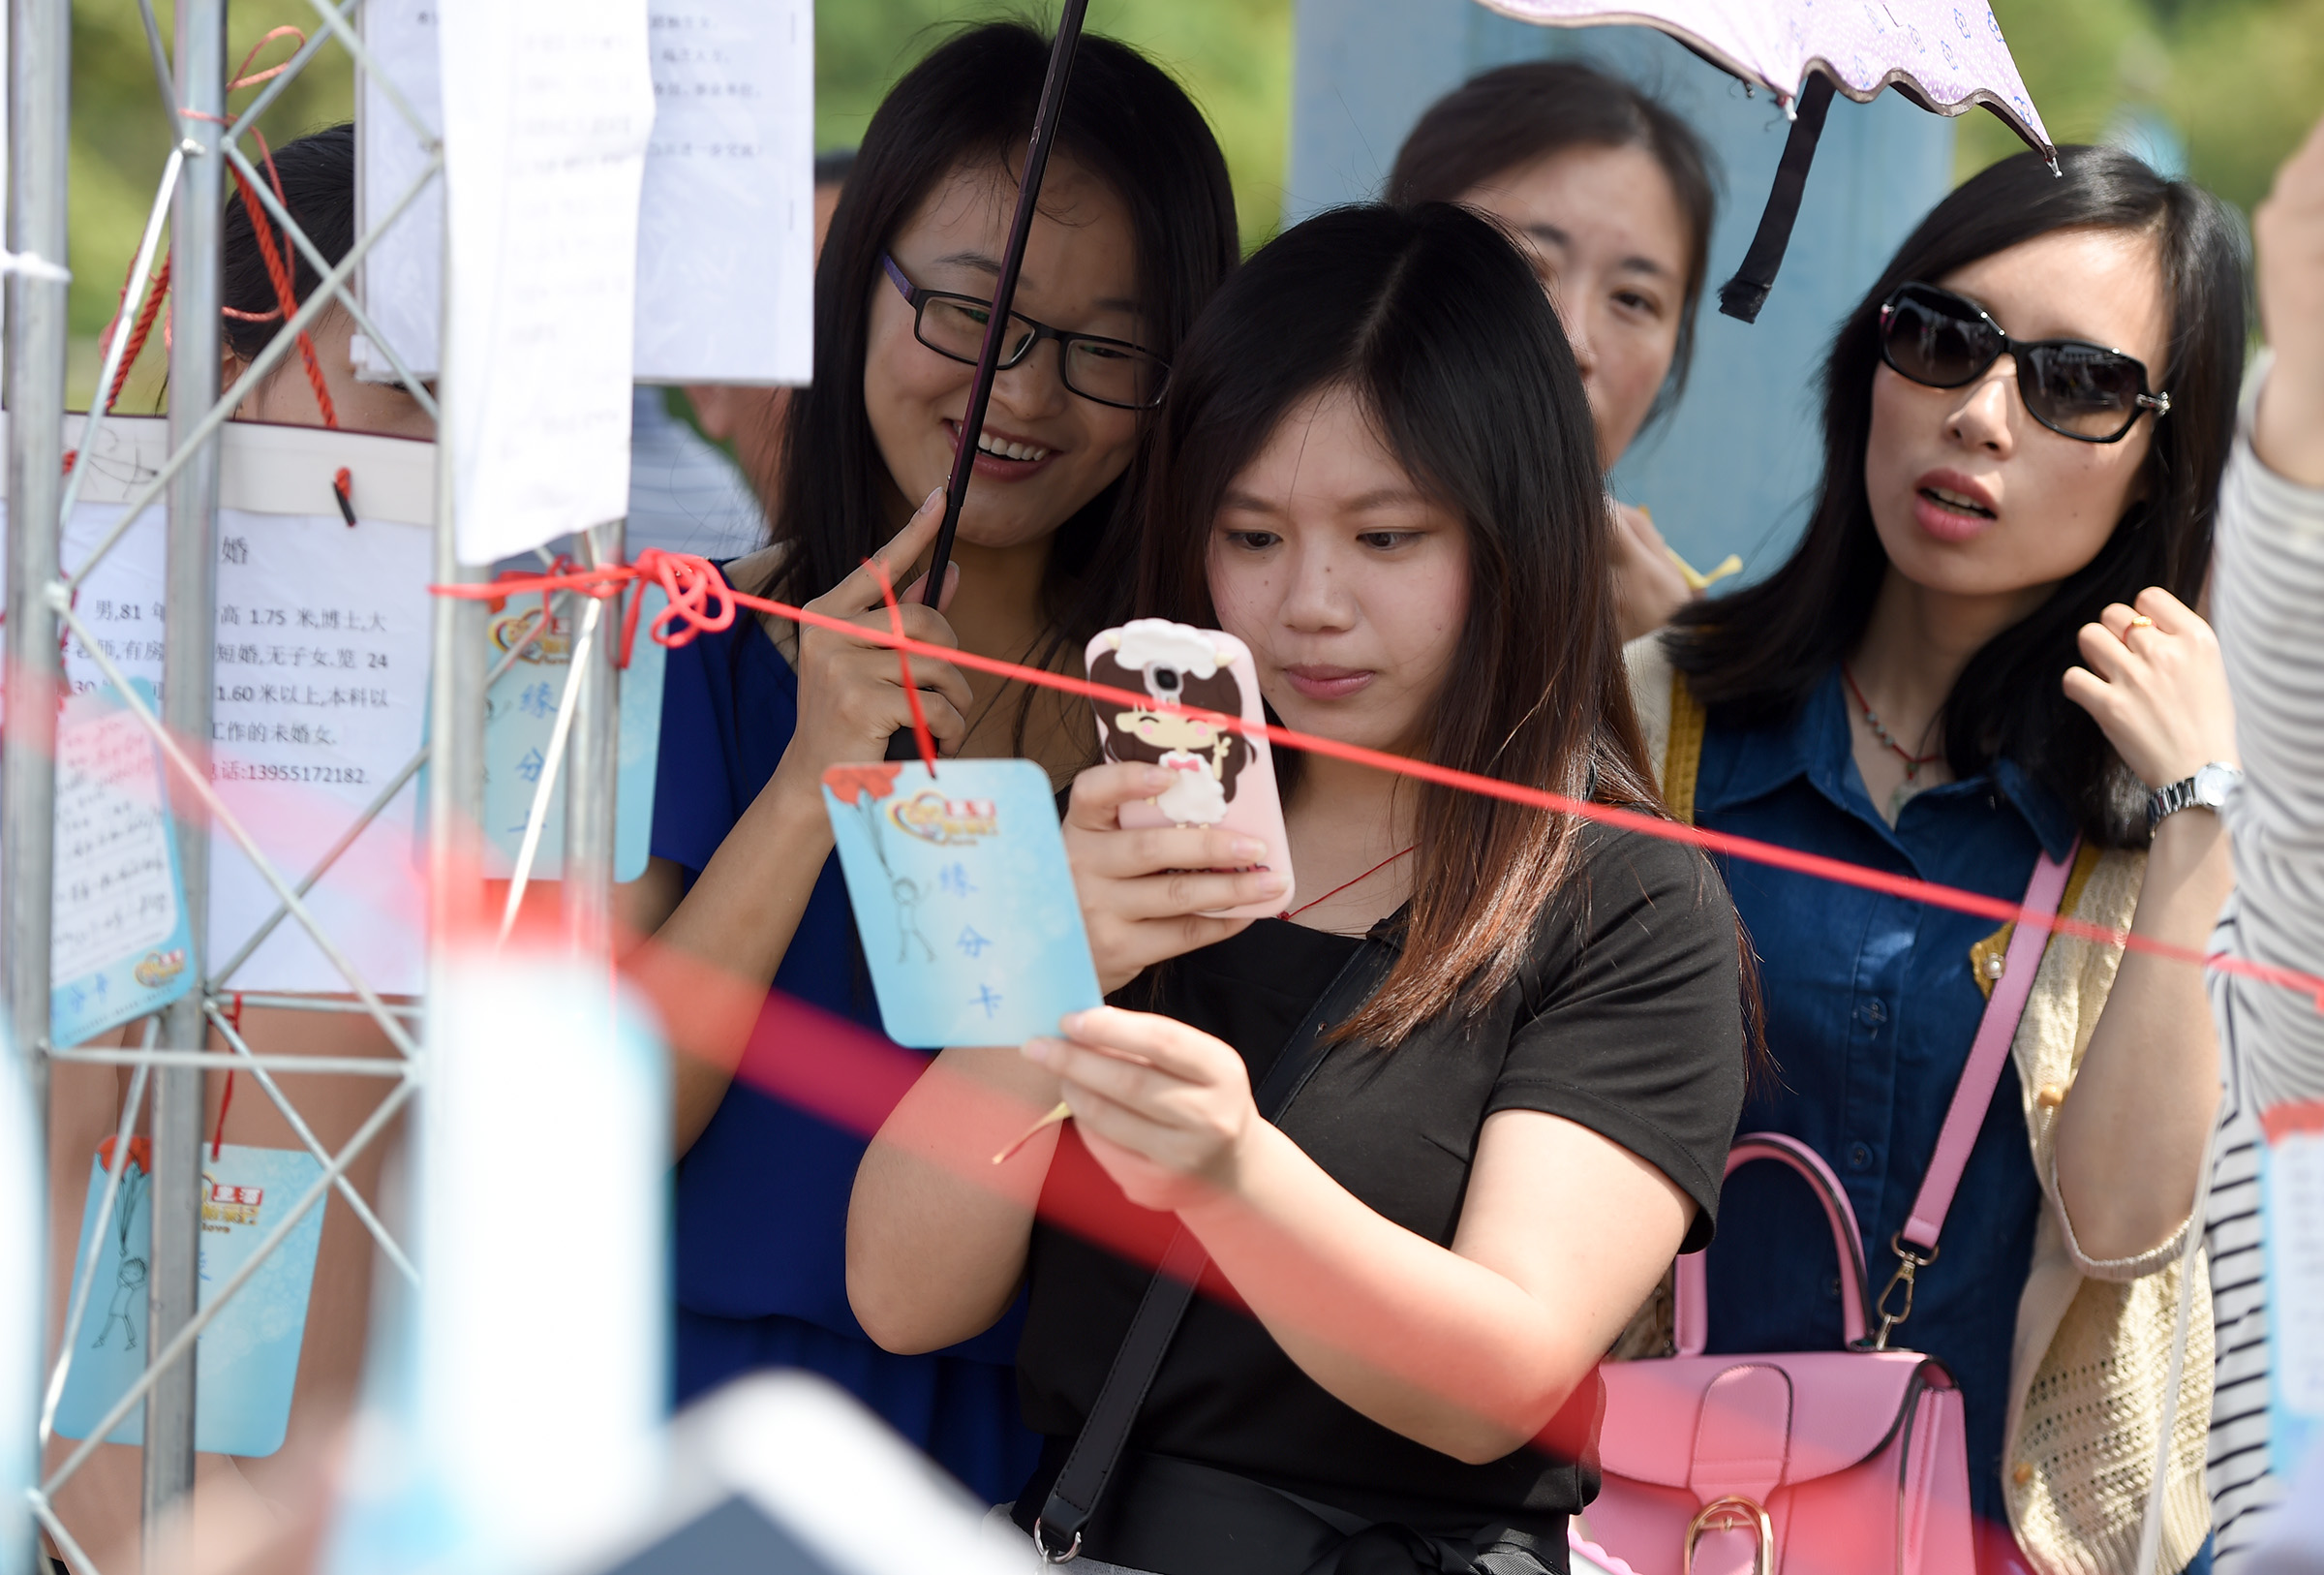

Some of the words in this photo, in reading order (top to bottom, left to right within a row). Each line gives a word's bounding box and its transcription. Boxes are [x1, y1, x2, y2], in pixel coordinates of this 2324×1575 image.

[222, 536, 249, 565] 婚
[96, 600, 141, 621] 男,81
[249, 608, 287, 626] 1.75
[367, 652, 389, 668] 24
[217, 686, 254, 702] 1.60
[211, 761, 370, 786] 话:13955172182.
